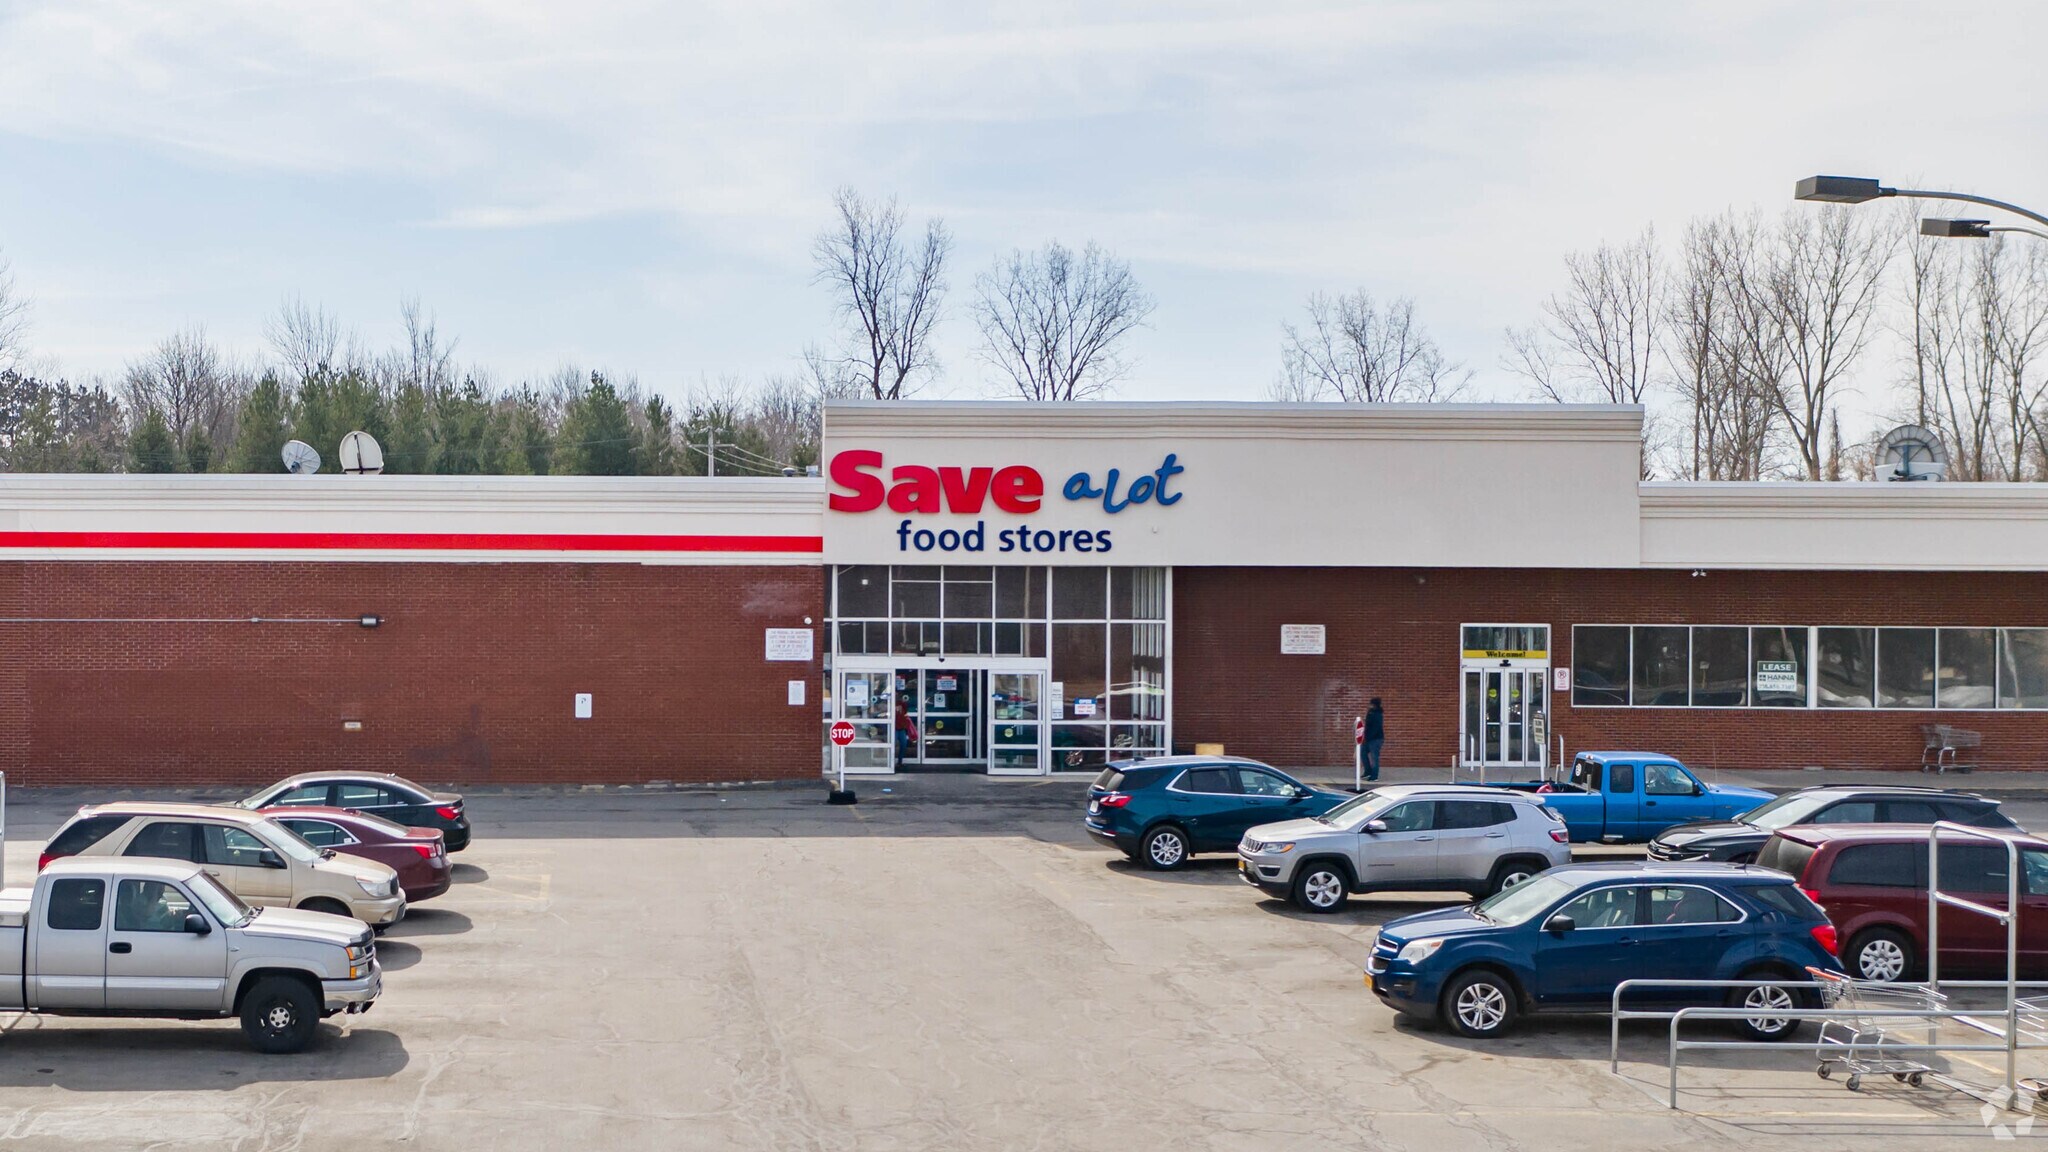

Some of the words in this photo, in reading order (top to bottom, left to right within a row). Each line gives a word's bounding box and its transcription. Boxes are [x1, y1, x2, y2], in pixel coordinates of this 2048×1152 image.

[829, 449, 1044, 514] Save
[897, 519, 985, 552] food
[999, 525, 1113, 553] stores
[1486, 650, 1526, 658] Welcome!
[1762, 663, 1792, 671] LEASE
[832, 728, 854, 739] STOP
